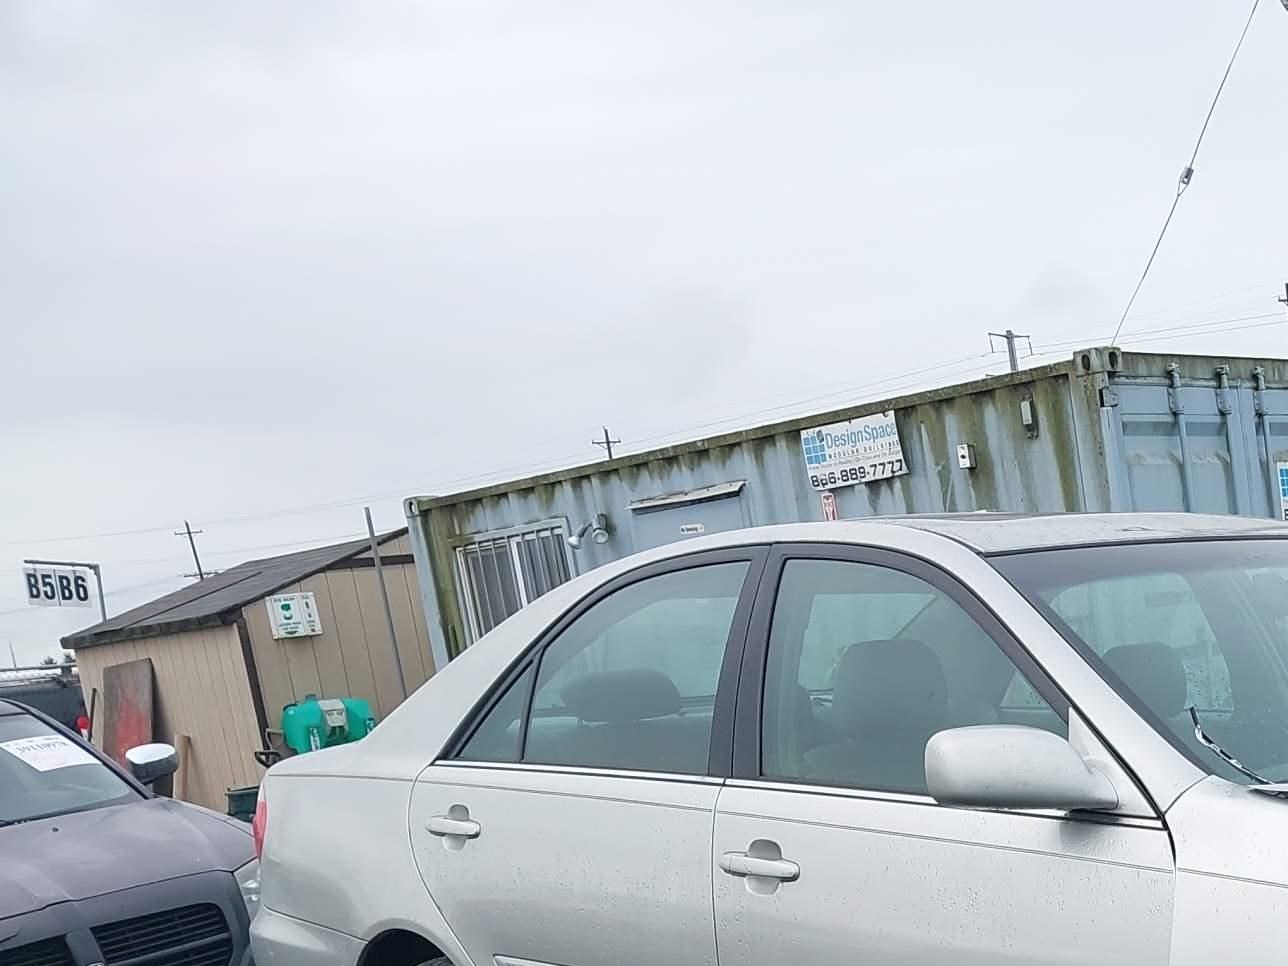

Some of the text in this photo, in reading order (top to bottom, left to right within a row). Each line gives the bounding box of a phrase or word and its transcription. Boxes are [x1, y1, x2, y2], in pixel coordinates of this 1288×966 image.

[824, 423, 897, 449] DesignSpace
[26, 573, 88, 602] B5 B6
